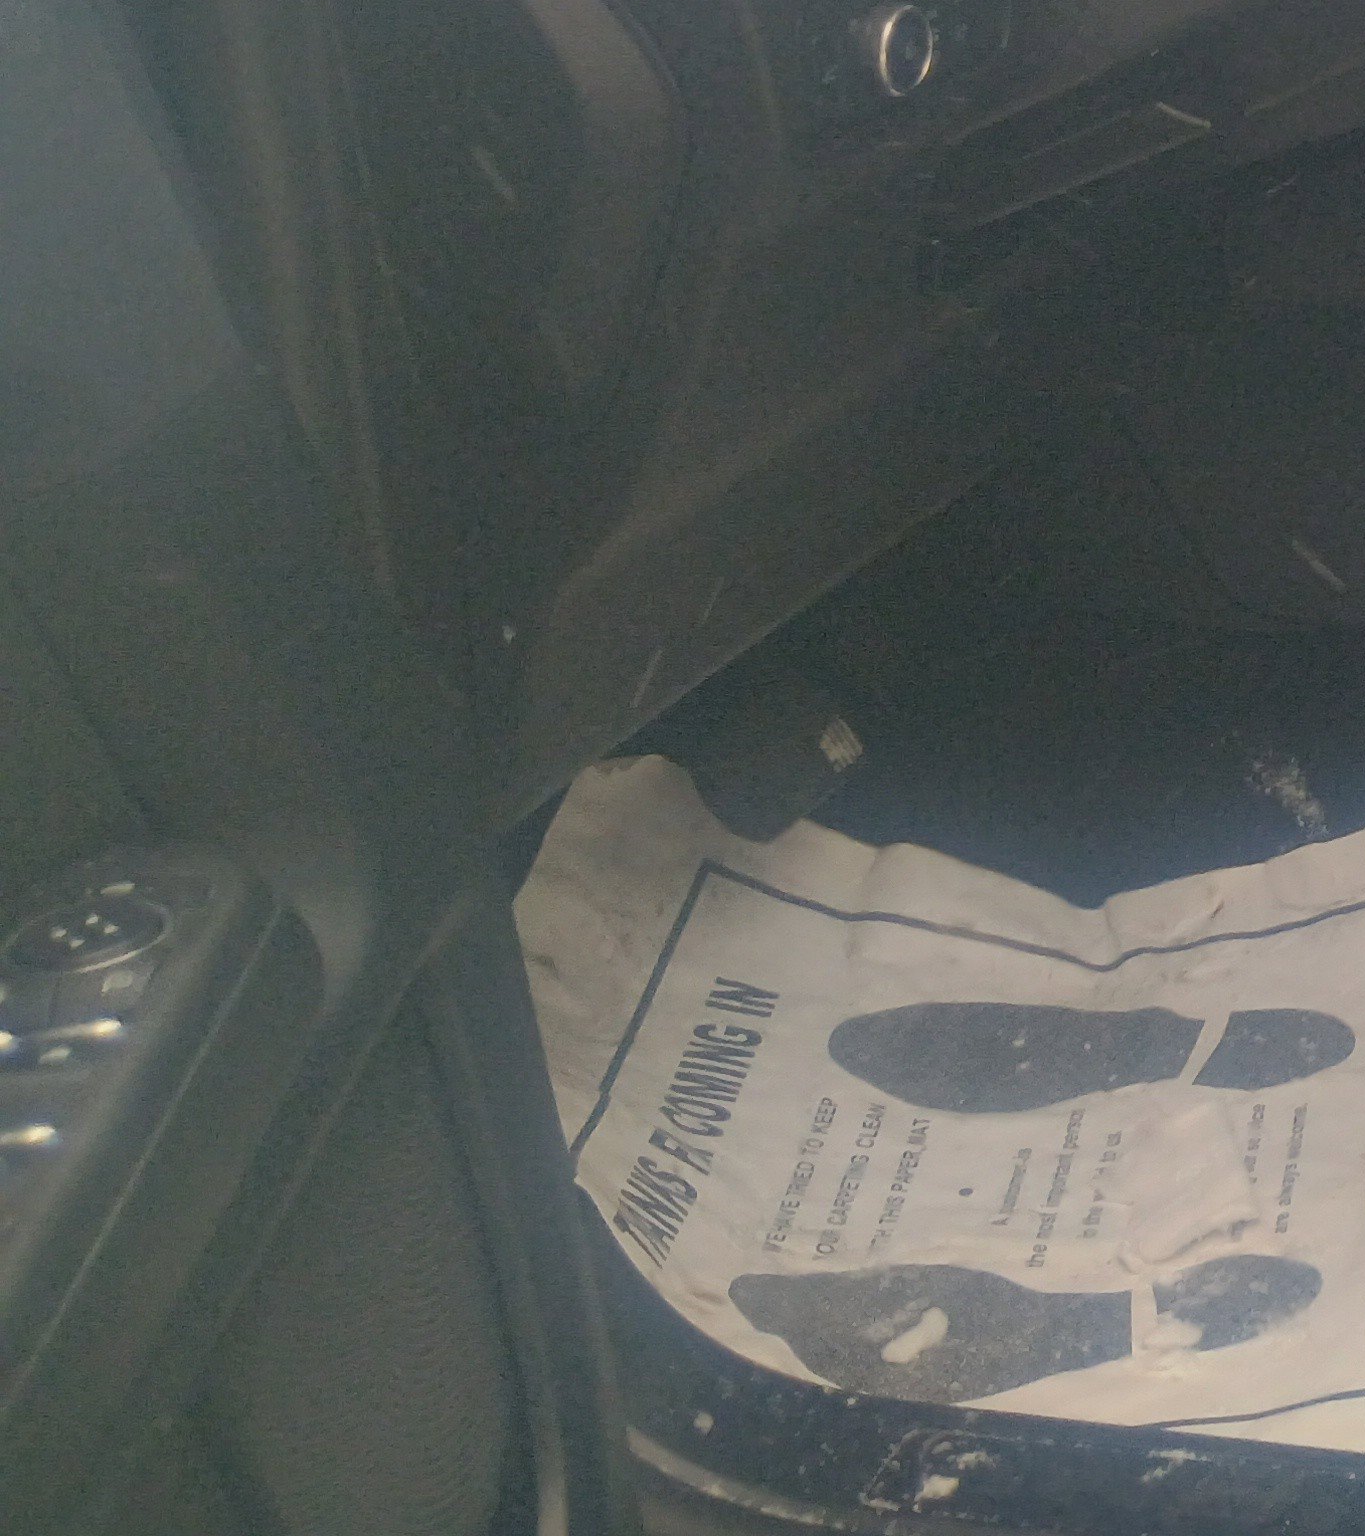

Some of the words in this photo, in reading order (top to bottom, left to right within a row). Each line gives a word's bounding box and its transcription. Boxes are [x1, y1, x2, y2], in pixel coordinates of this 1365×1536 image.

[705, 976, 780, 1018] IN
[659, 1023, 763, 1137] COMING
[811, 1097, 838, 1135] KEEP
[855, 1102, 887, 1149] CLEAN
[1025, 1244, 1048, 1268] the
